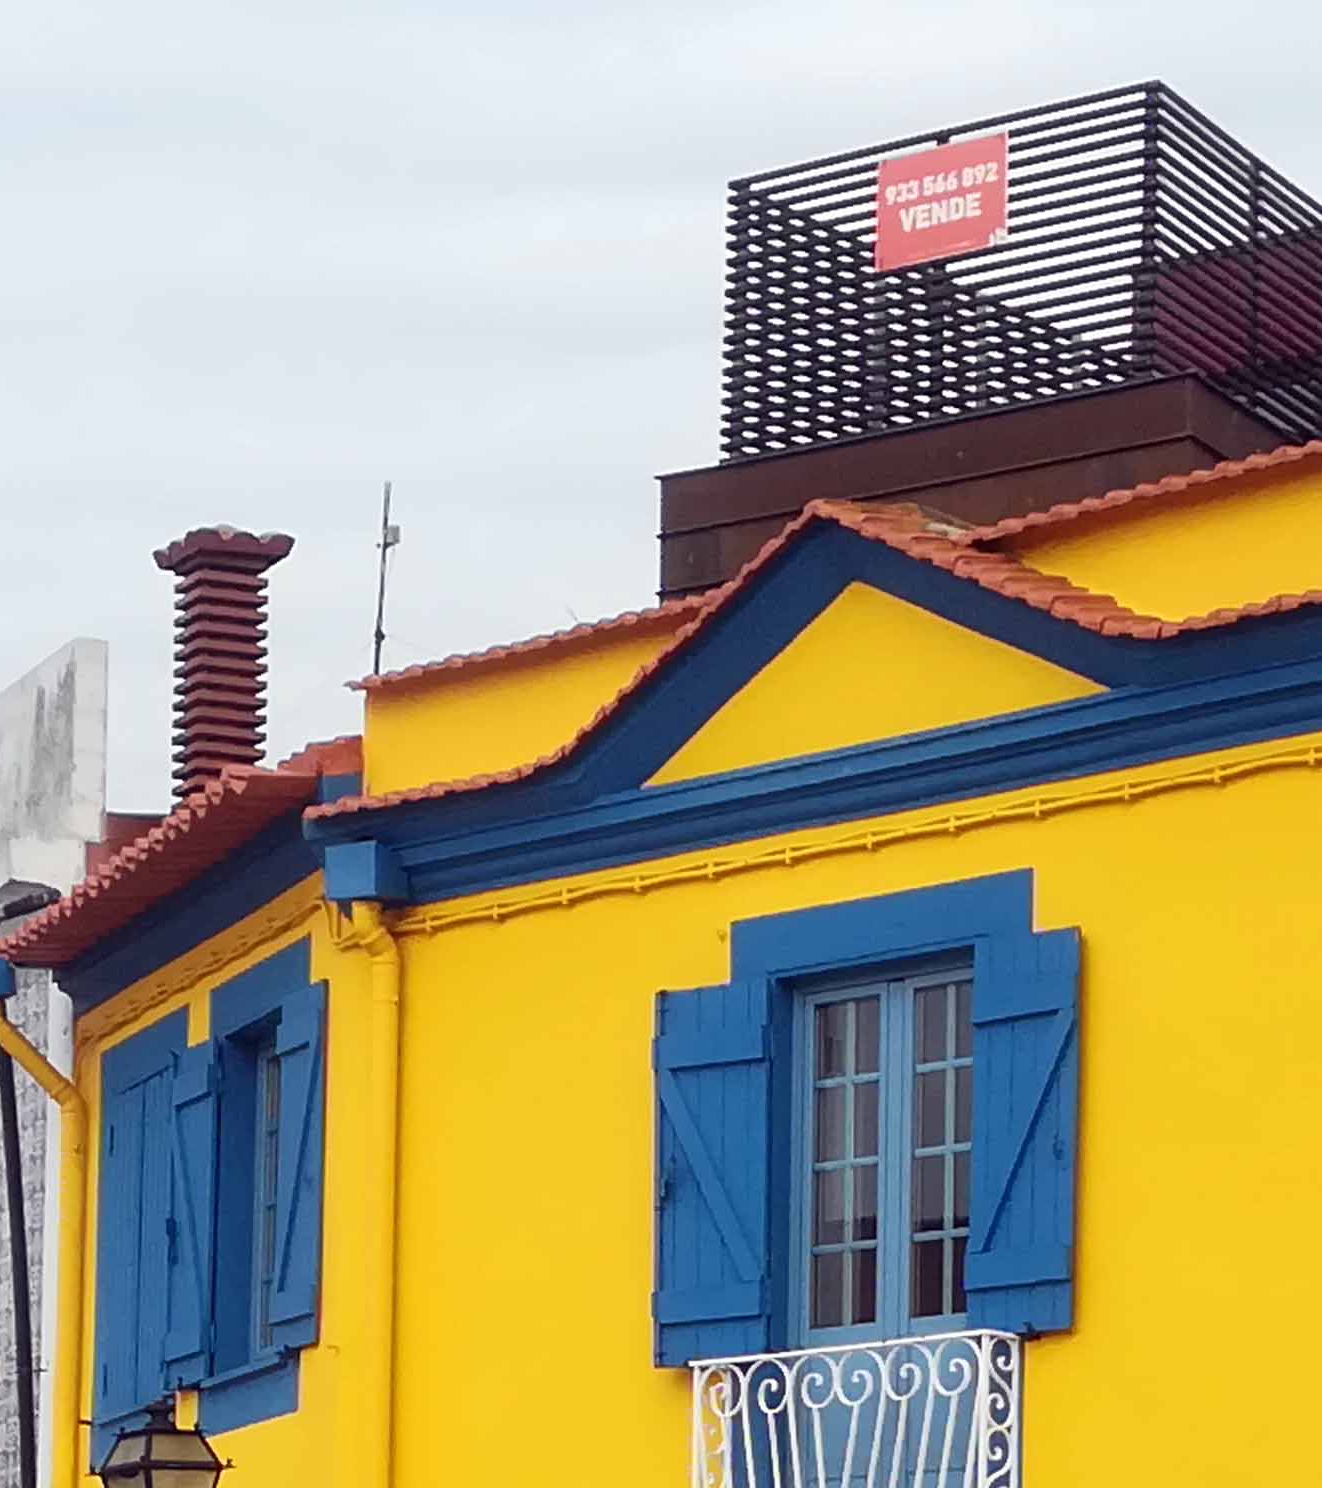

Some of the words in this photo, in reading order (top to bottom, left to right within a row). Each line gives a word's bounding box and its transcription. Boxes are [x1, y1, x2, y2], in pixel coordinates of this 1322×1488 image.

[885, 179, 919, 206] 933
[922, 170, 958, 197] 566
[961, 161, 998, 188] 892
[899, 192, 982, 232] VENDE
